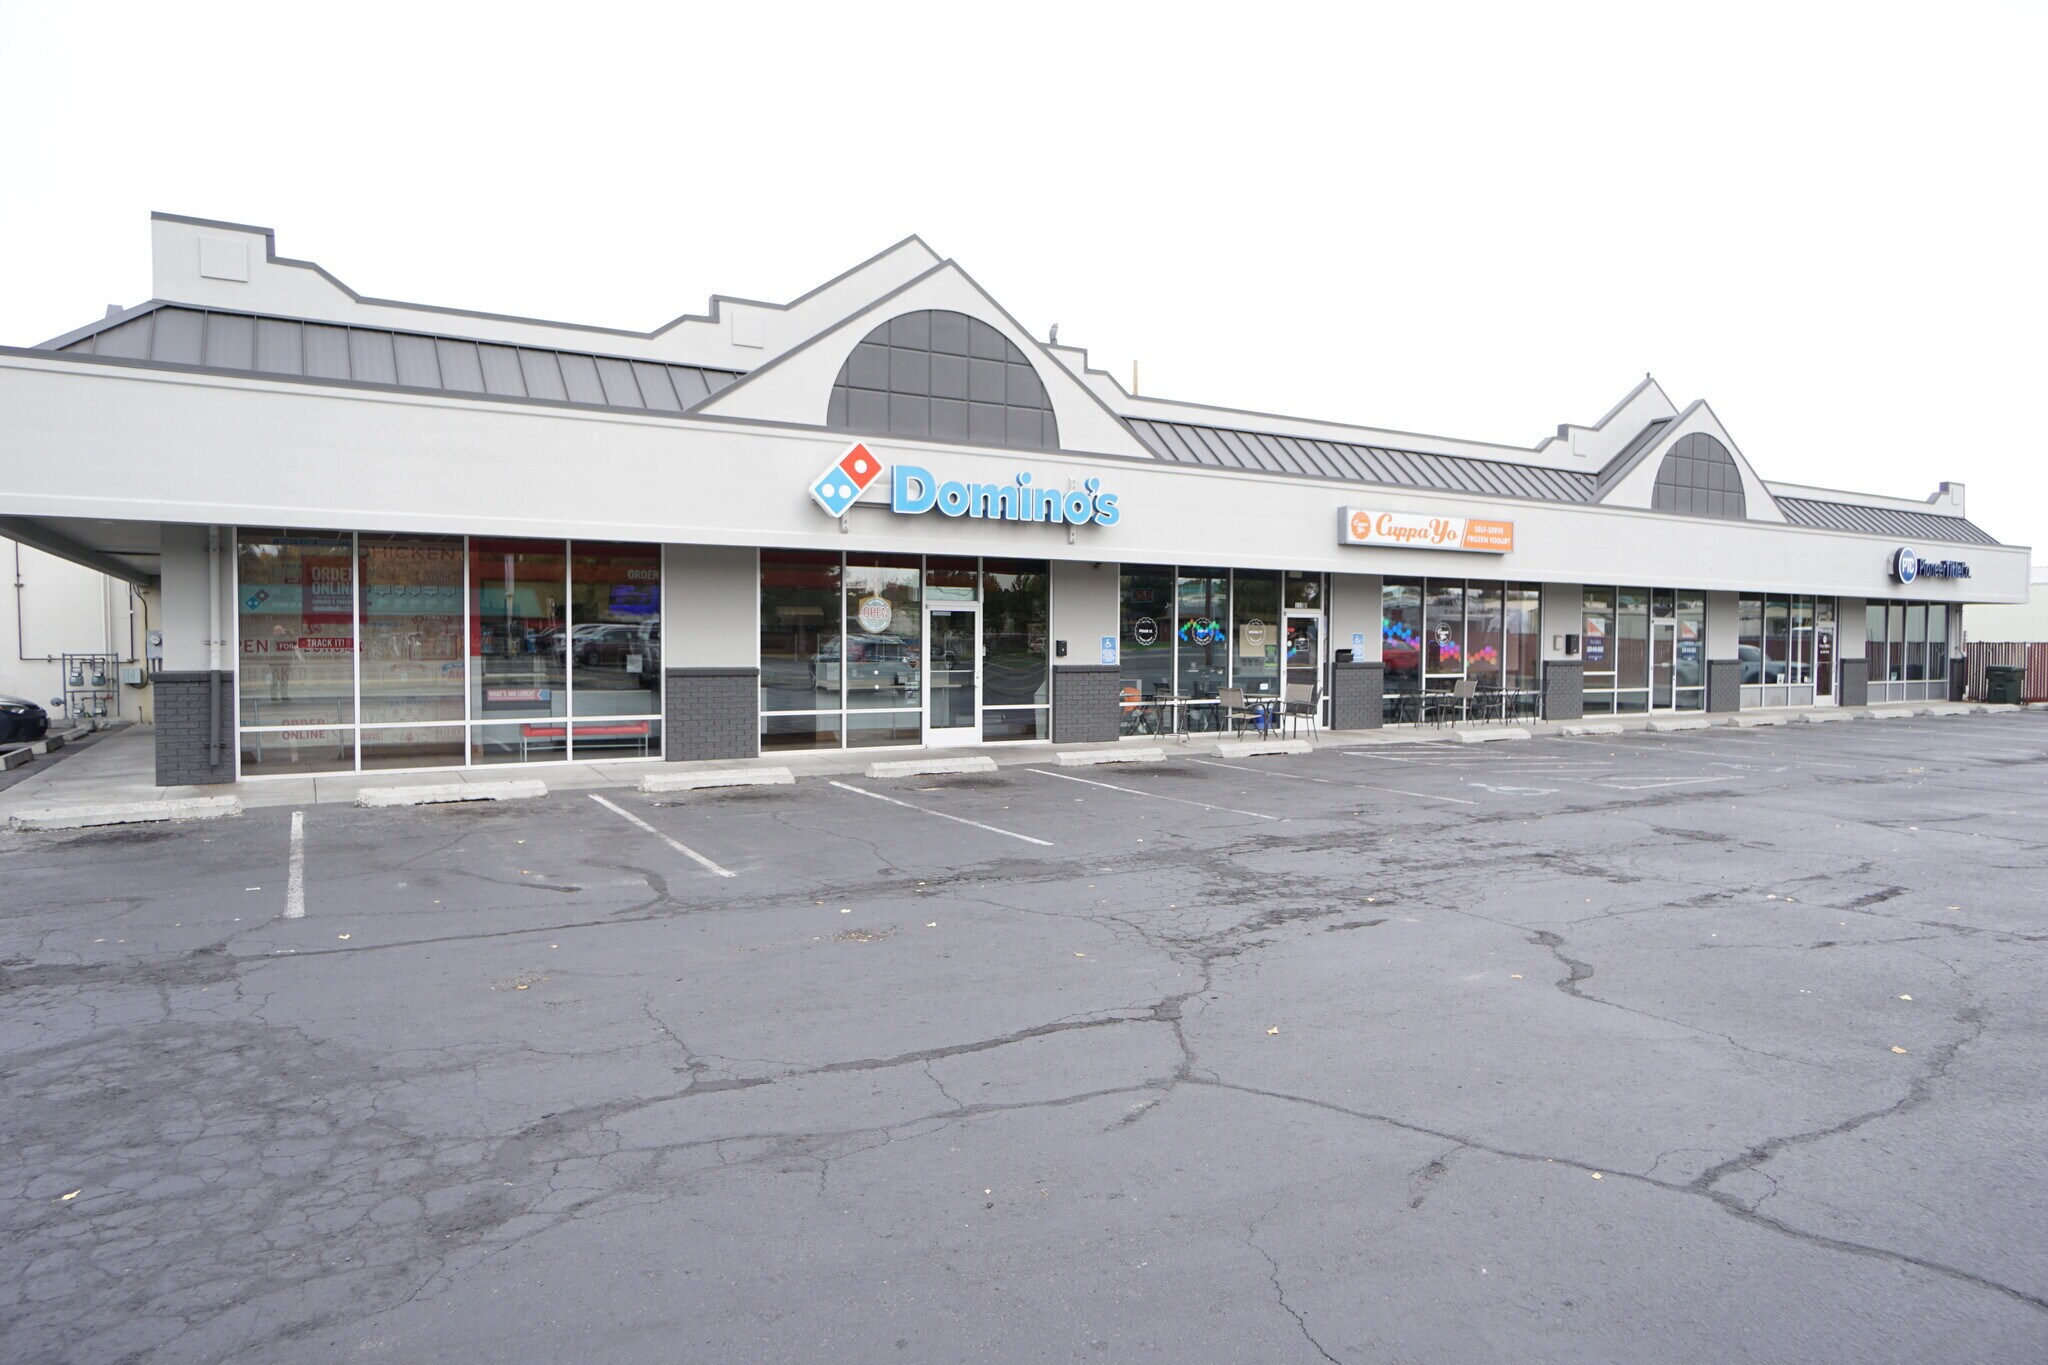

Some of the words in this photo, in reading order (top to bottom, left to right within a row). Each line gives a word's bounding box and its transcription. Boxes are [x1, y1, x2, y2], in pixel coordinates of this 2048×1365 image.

[891, 464, 1120, 528] Domino's
[1376, 513, 1429, 542] Cuppa
[1429, 518, 1458, 545] Yo
[1474, 525, 1504, 534] SELF-SERVE
[1467, 535, 1488, 543] FROZEN
[1902, 557, 1915, 573] PTC
[1918, 558, 1945, 577] Pioneer
[628, 569, 660, 580] ORDER
[312, 581, 353, 595] ONLIN
[863, 605, 889, 620] OPEN
[307, 638, 333, 647] TRACK
[335, 638, 345, 647] IT!
[282, 730, 325, 740] ONLINE
